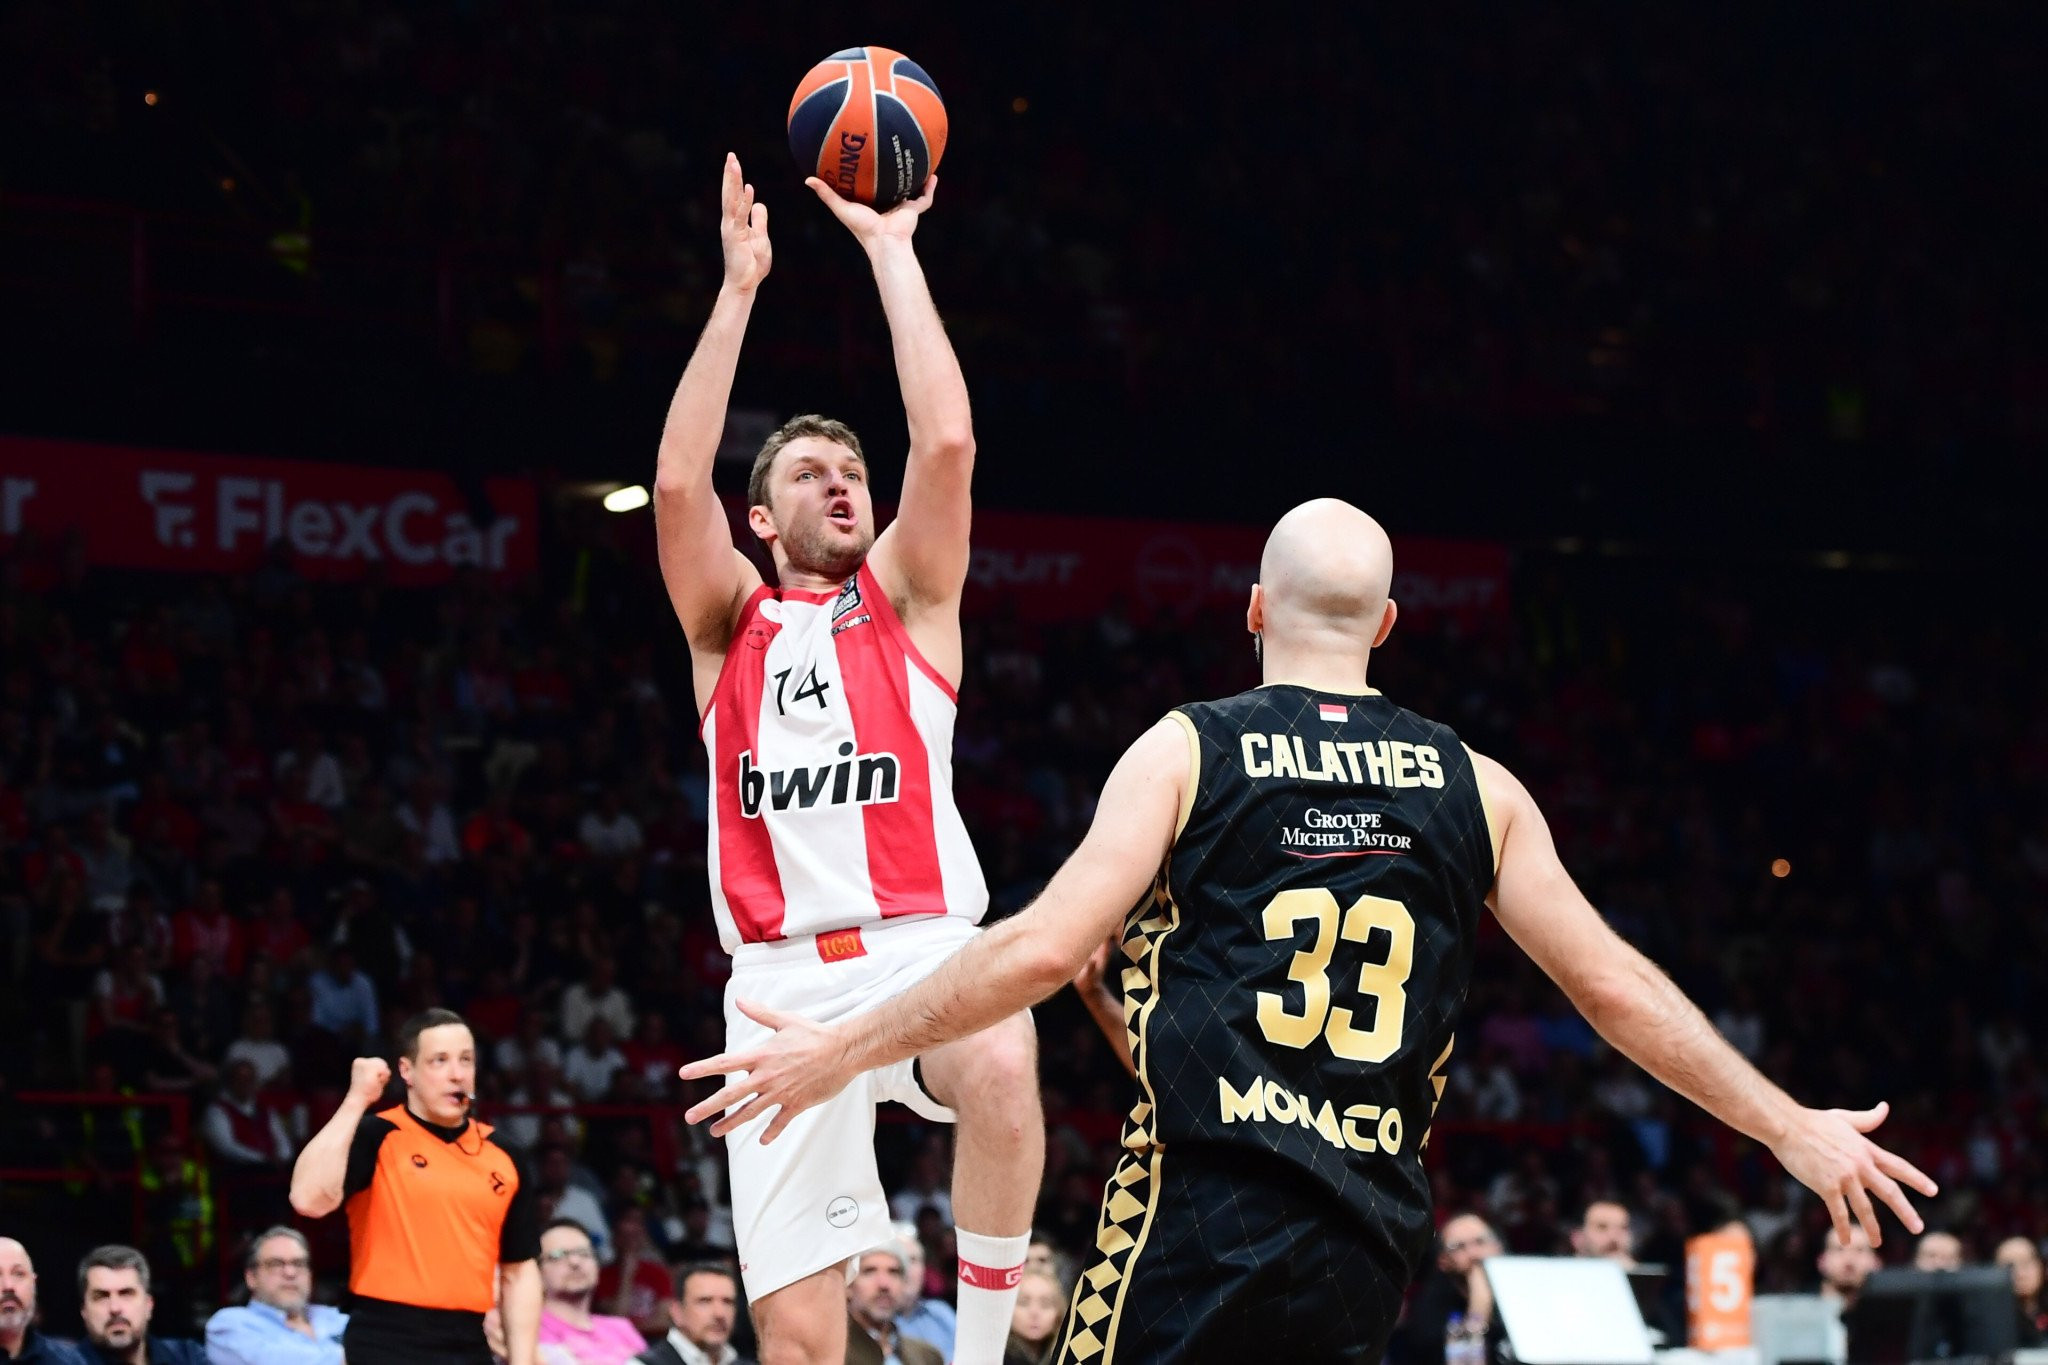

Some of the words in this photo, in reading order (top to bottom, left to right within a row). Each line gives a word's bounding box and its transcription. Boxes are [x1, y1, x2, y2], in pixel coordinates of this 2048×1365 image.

[214, 475, 520, 572] FlexCar
[773, 658, 830, 716] 14
[740, 741, 898, 818] bwin
[1240, 732, 1446, 790] CALATHES
[1255, 887, 1416, 1064] 33
[1218, 1074, 1403, 1156] MONACO
